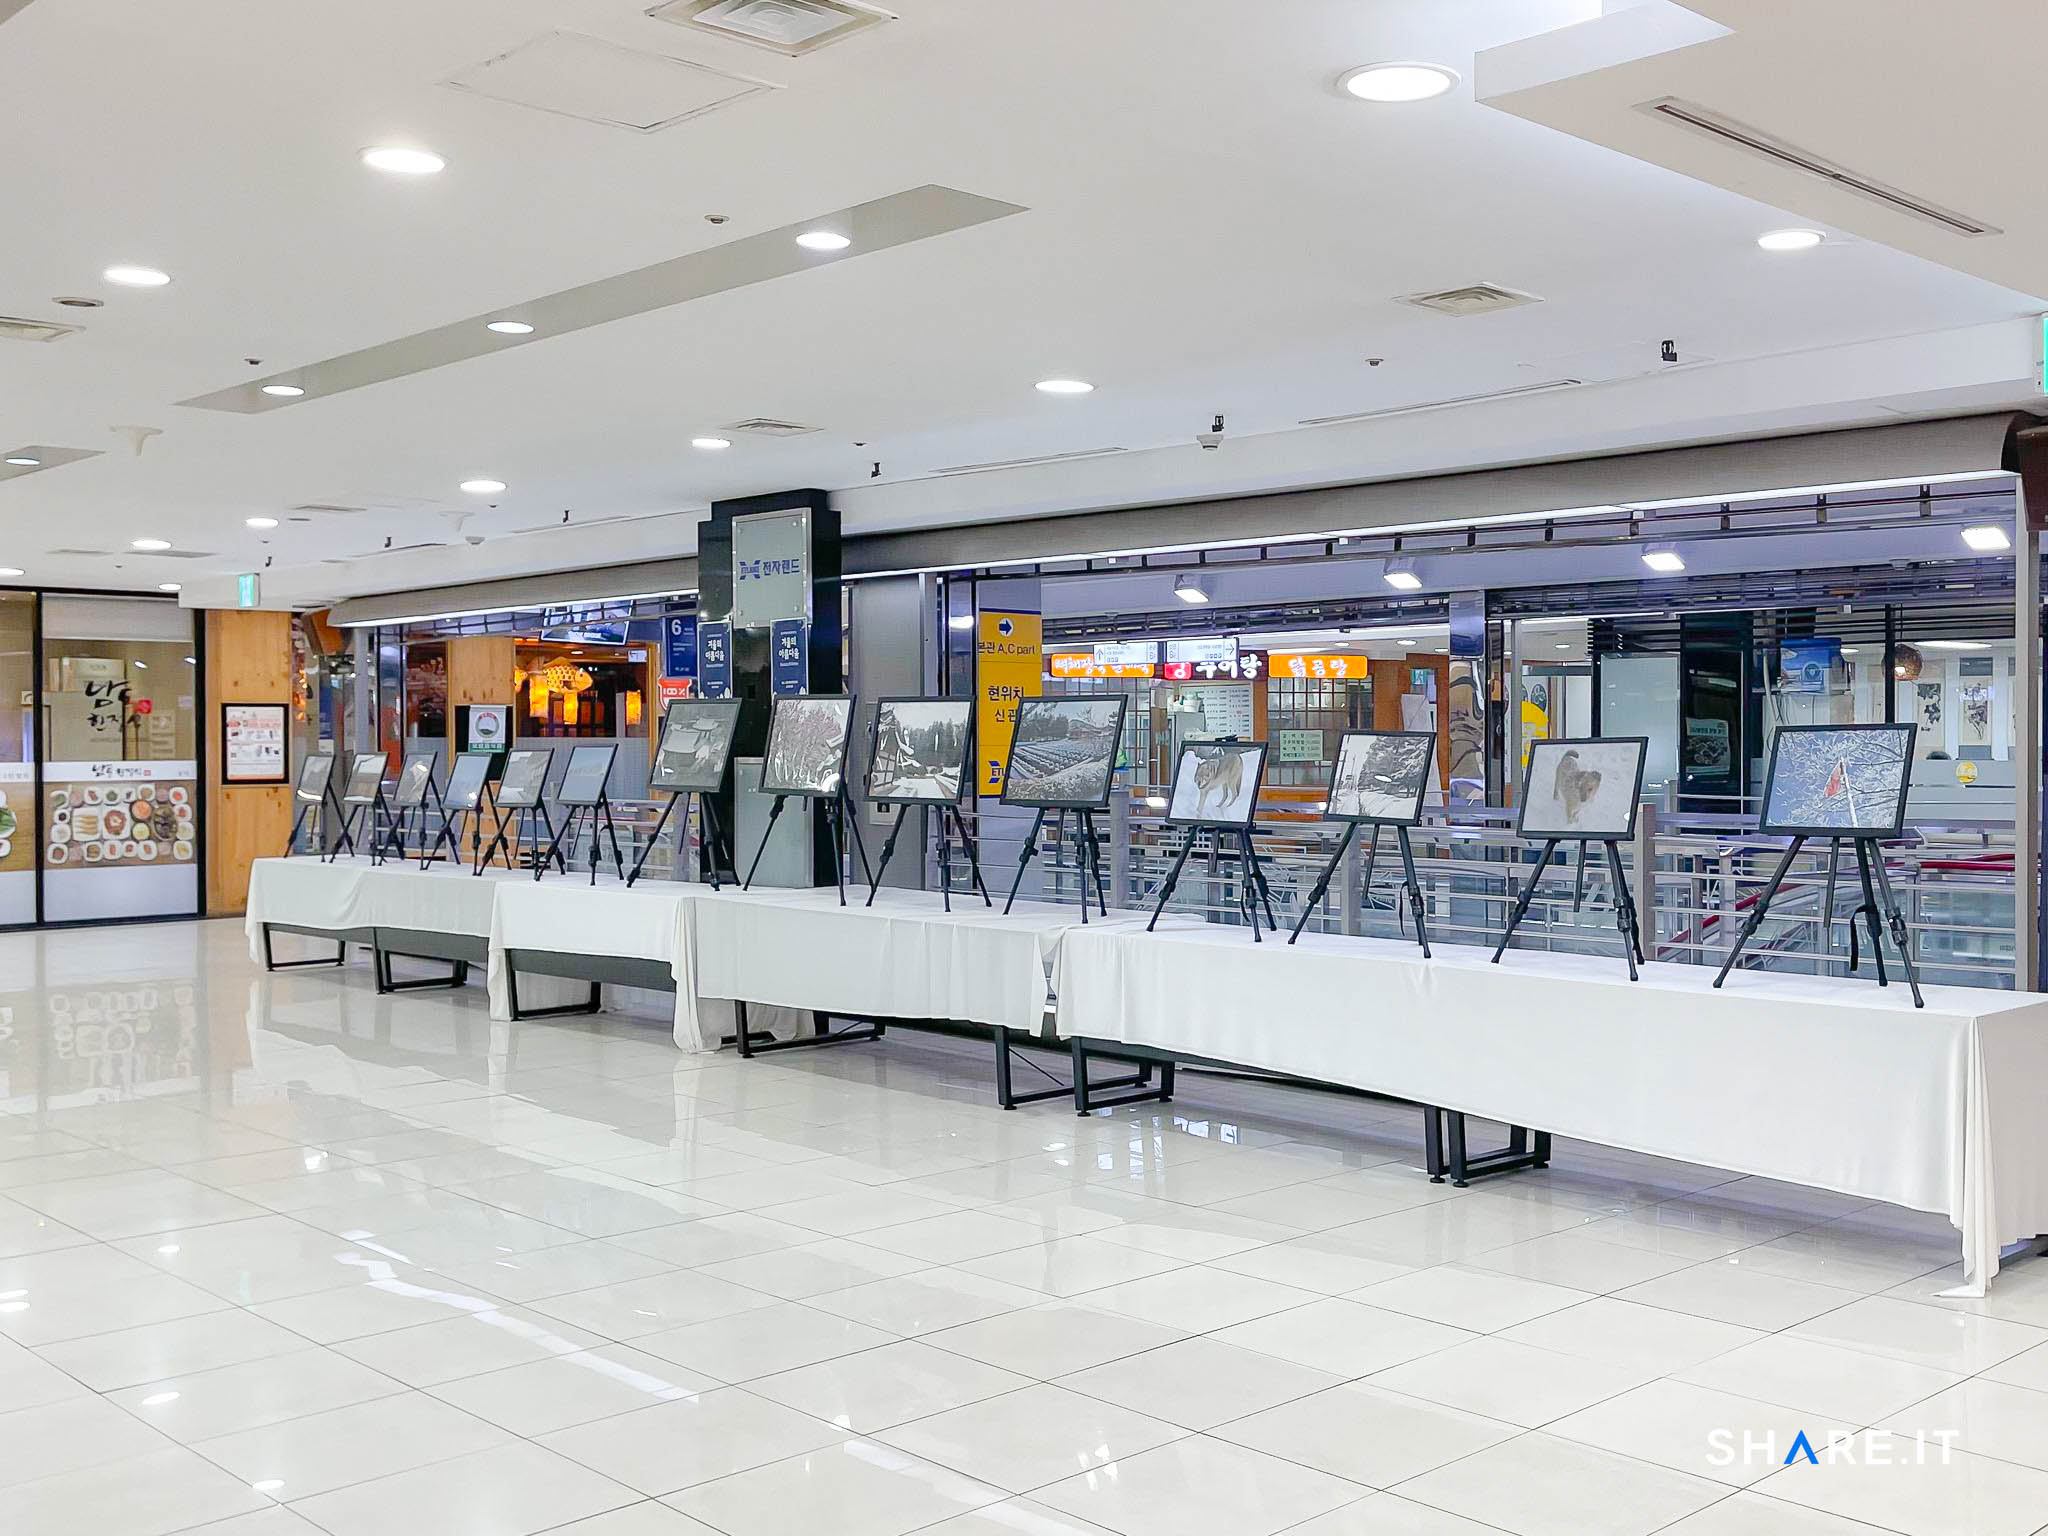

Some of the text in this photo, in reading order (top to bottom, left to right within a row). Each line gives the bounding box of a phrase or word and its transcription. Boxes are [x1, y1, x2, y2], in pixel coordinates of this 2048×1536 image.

[763, 559, 800, 576] 전자랜드
[672, 619, 682, 636] 6
[1016, 645, 1035, 656] part
[988, 686, 1024, 701] 현위치
